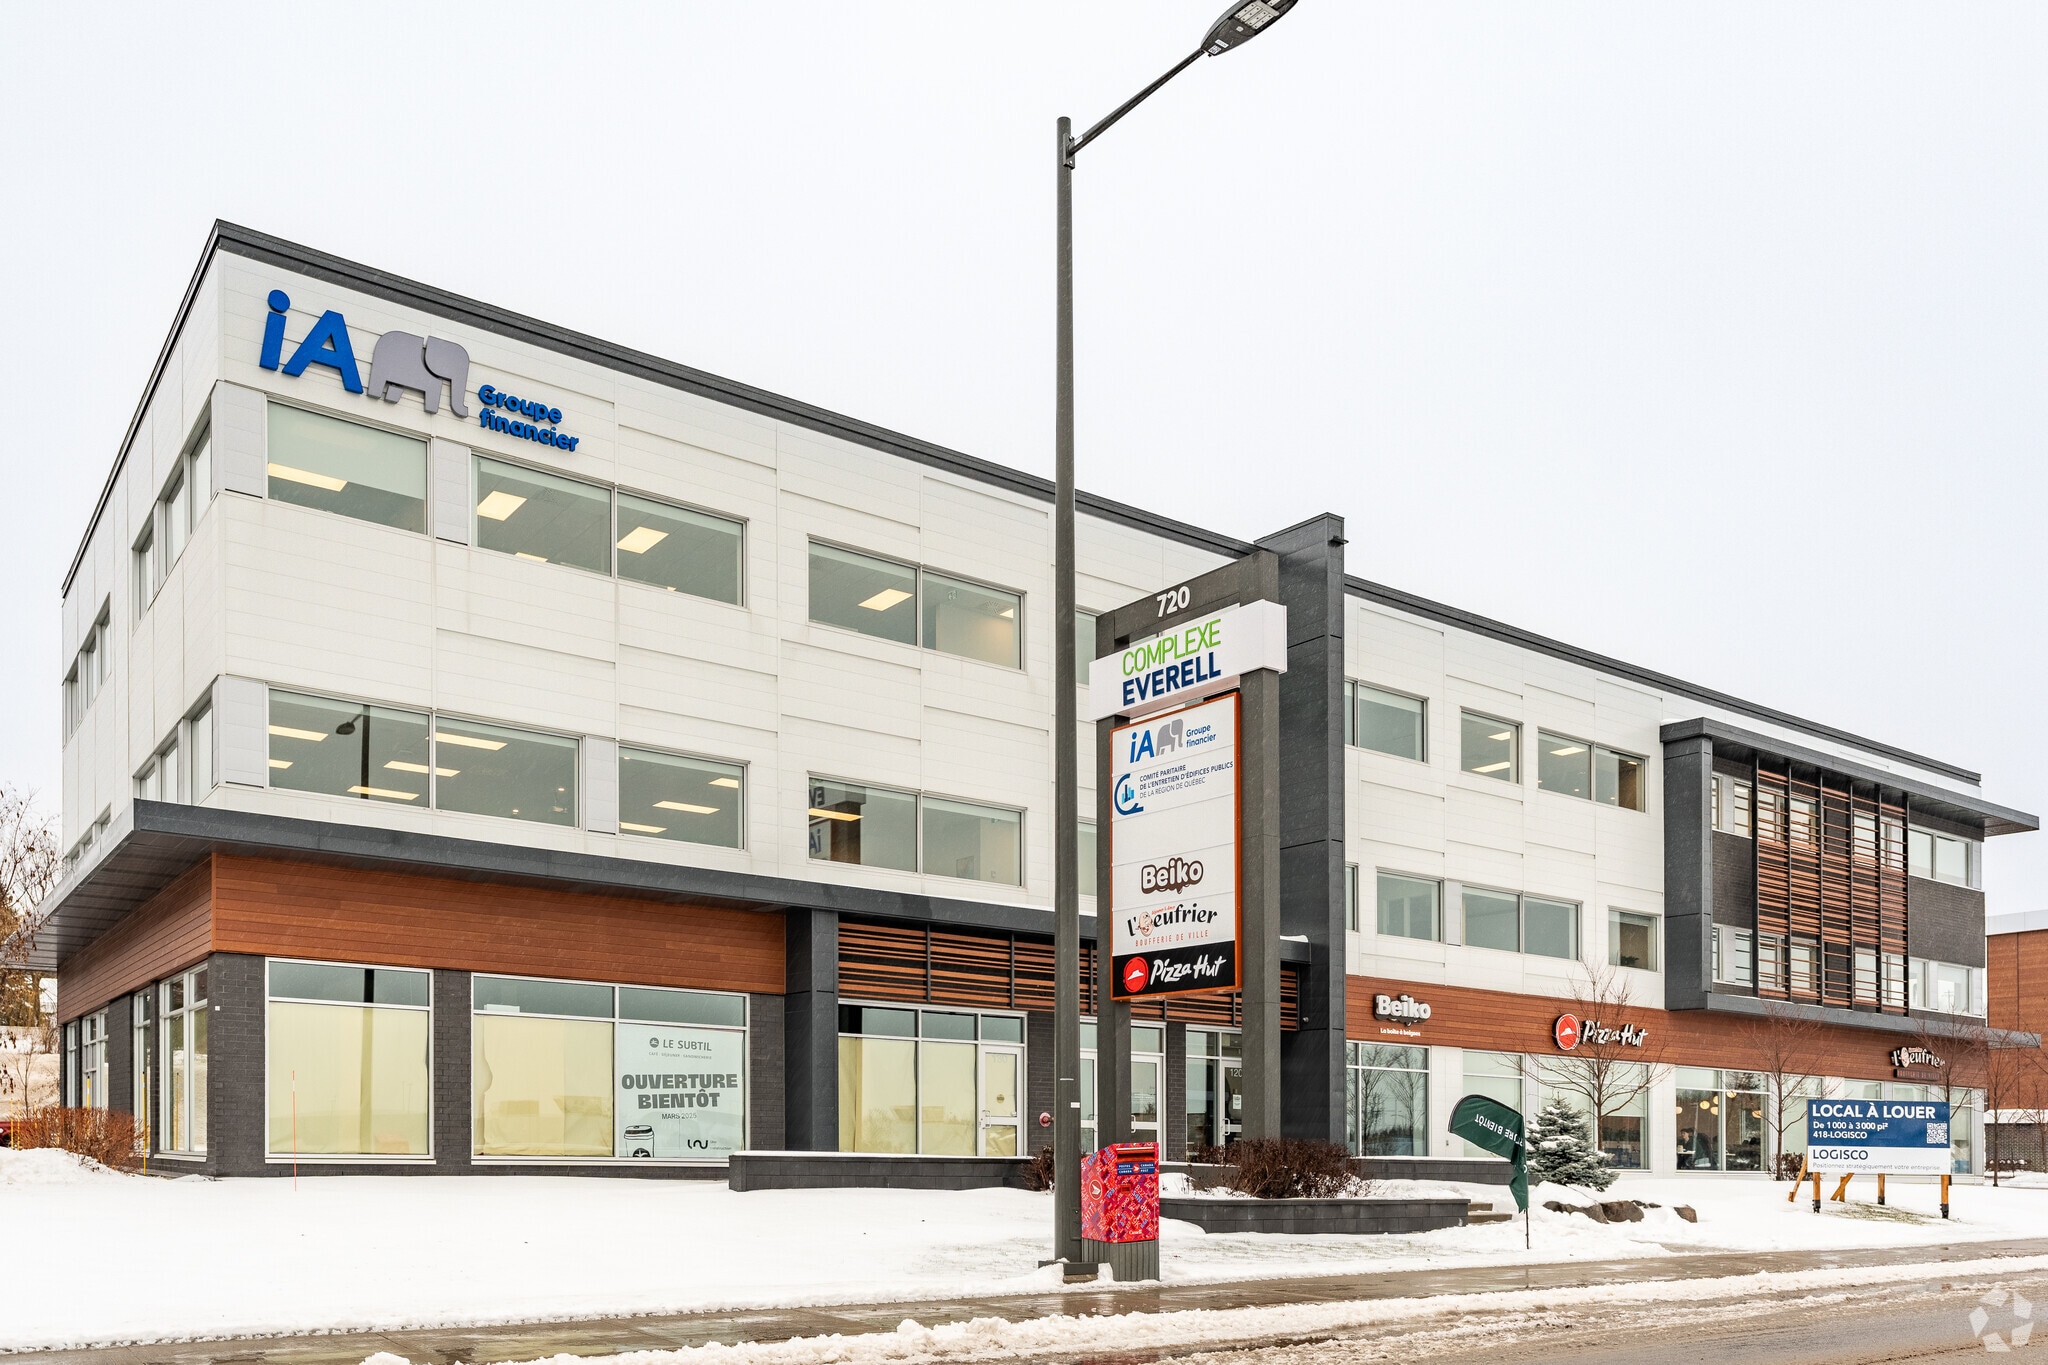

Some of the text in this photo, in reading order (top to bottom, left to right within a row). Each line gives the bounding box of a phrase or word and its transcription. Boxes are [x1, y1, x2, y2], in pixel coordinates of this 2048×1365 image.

[259, 289, 364, 395] iA
[478, 384, 563, 424] Groupe
[479, 407, 580, 452] financier
[1156, 585, 1191, 618] 720
[1122, 618, 1222, 677] COMPLEXE
[1122, 652, 1222, 707] EVERELL
[1186, 724, 1211, 738] Groupe
[1186, 733, 1217, 748] financier
[1130, 729, 1155, 764] iA
[1139, 764, 1186, 782] COMITÉ PARITAIRE
[1147, 775, 1180, 788] L'ENTRETIEN
[1181, 767, 1210, 780] D'ÉDIFICES
[1210, 761, 1233, 773] PUBLICS
[1139, 791, 1147, 799] DE
[1147, 789, 1155, 797] LA
[1176, 782, 1183, 790] DE
[1141, 857, 1203, 893] Beiko
[1135, 929, 1209, 947] BOUFFERIE DE VILLE
[1150, 954, 1227, 985] Pizza Hut
[1374, 993, 1432, 1021] Beiko
[1582, 1020, 1649, 1047] Pizza Hut
[663, 1039, 712, 1051] LE SUBTIL
[621, 1073, 738, 1090] OUVERTURE
[637, 1088, 720, 1109] BIENTÔT
[1812, 1102, 1936, 1119] LOCAL À LOUER
[1474, 1113, 1504, 1135] BIENTÔT
[1812, 1131, 1868, 1139] 418-LOGISCO
[1813, 1121, 1825, 1129] De
[1848, 1121, 1854, 1129] à
[1812, 1149, 1869, 1160] LOGISCO
